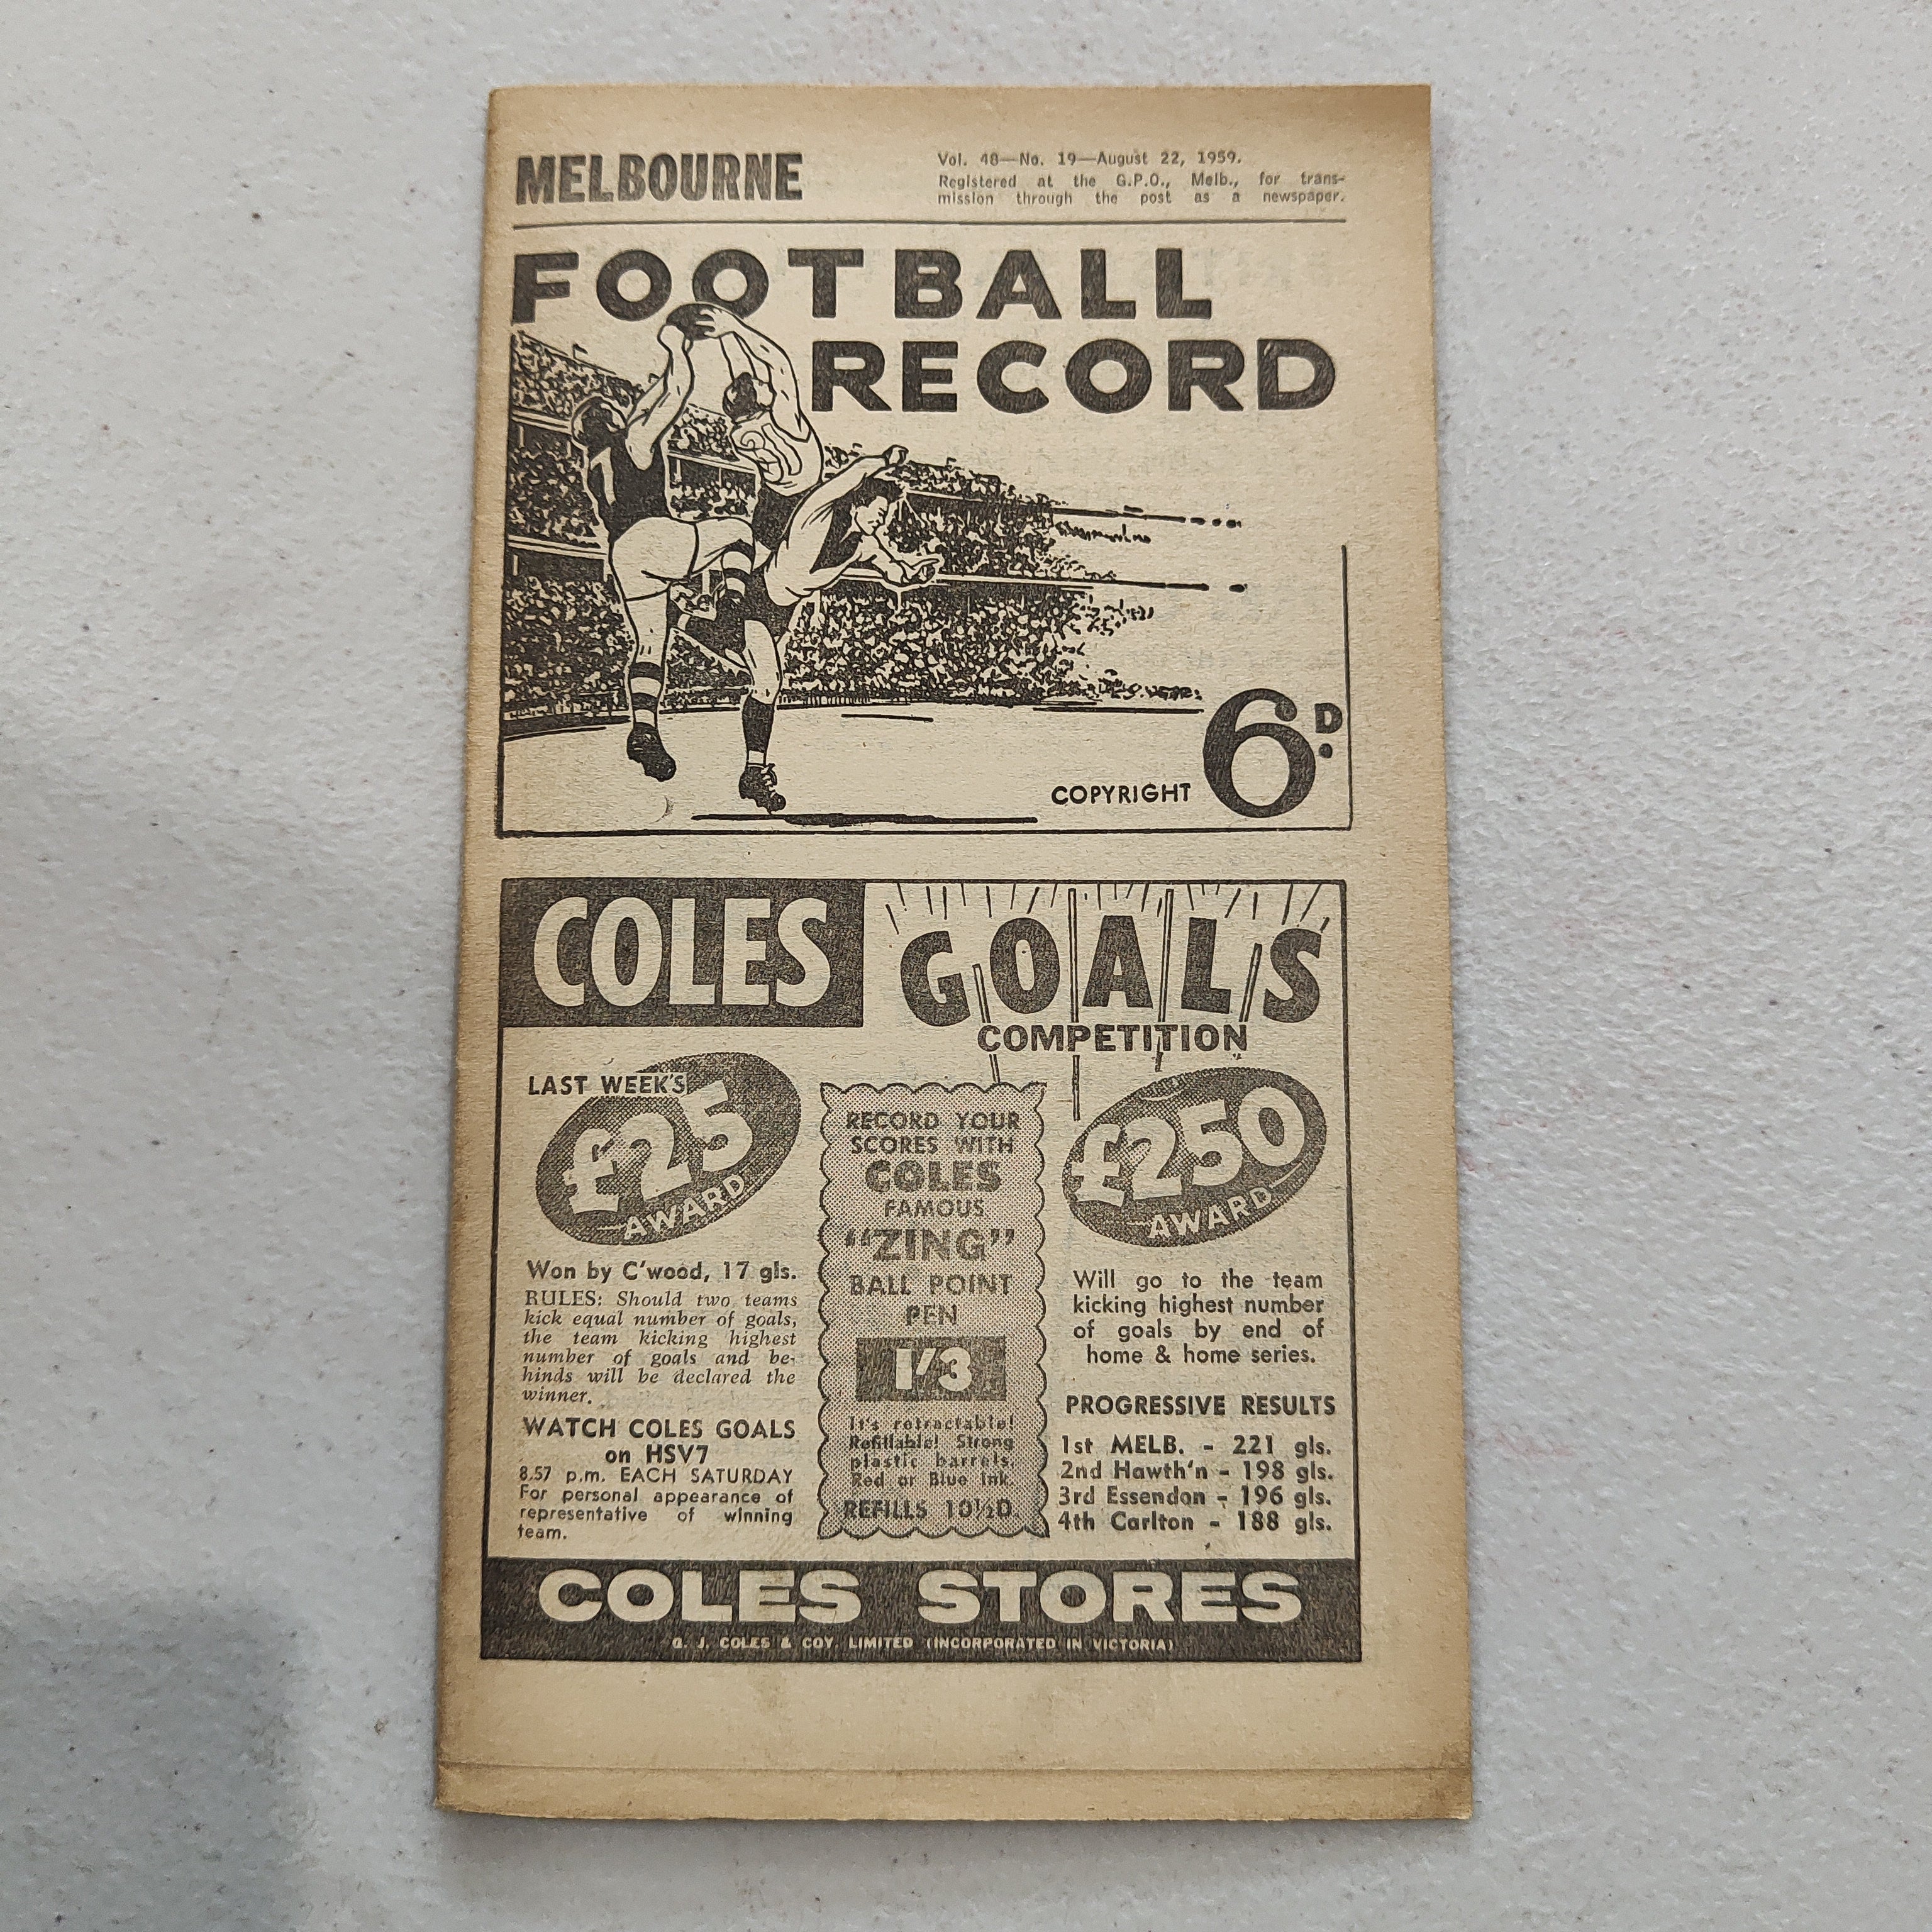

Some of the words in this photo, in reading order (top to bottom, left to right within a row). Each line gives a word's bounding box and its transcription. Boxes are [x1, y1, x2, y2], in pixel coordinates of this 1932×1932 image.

[937, 151, 967, 166] Vol.
[1160, 150, 1185, 167] 22,
[1198, 150, 1241, 165] 1959.
[516, 153, 803, 206] MELBOURNE
[938, 175, 1016, 190] Registered
[1037, 175, 1053, 187] at
[1073, 174, 1096, 187] the
[1116, 172, 1170, 189] G.P.O.,
[1191, 172, 1239, 187] Melb.,
[1259, 170, 1280, 186] for
[1301, 171, 1345, 186] trans-
[938, 191, 994, 205] mission
[1016, 191, 1072, 207] through
[1095, 191, 1118, 204] the
[1140, 191, 1172, 206] post
[1194, 192, 1209, 203] as
[1232, 192, 1240, 203] a
[1263, 191, 1345, 205] newspaper.
[511, 248, 1212, 326] FOOTBALL
[811, 338, 1336, 414] RECORD
[1051, 782, 1191, 806] COPYRIGHT
[533, 896, 831, 1008] COLES
[900, 915, 1322, 1027] GOALS
[977, 1024, 1248, 1052] COMPETITION
[528, 1075, 587, 1096] LAST
[601, 1073, 687, 1096] WEEK'S
[846, 1111, 939, 1130] RECORD
[955, 1112, 1019, 1130] YOUR
[561, 1079, 753, 1214] £25
[852, 1136, 937, 1154] SCORES
[955, 1136, 1013, 1154] WITH
[1067, 1086, 1305, 1207] £250
[865, 1160, 1002, 1192] COLES
[624, 1174, 746, 1241] AWARD
[884, 1199, 984, 1218] FAMOUS
[1149, 1187, 1273, 1240] AWARD
[527, 1259, 576, 1280] Won
[587, 1260, 612, 1283] by
[623, 1260, 711, 1284] C'wood,
[723, 1260, 750, 1279] 17
[760, 1261, 797, 1284] gls.
[1072, 1268, 1114, 1289] Will
[1136, 1272, 1162, 1293] go
[1182, 1271, 1201, 1289] to
[1221, 1267, 1254, 1289] the
[1272, 1271, 1323, 1289] team
[850, 1275, 911, 1296] BALL
[930, 1274, 1012, 1296] POINT
[525, 1289, 603, 1307] RULES:
[616, 1291, 682, 1307] Should
[696, 1292, 731, 1307] two
[745, 1293, 797, 1307] teams
[1073, 1294, 1146, 1317] kicking
[1158, 1294, 1234, 1317] highest
[1244, 1294, 1324, 1314] number
[523, 1309, 562, 1326] kick
[572, 1310, 624, 1328] equal
[633, 1310, 706, 1326] number
[716, 1310, 735, 1328] of
[746, 1310, 797, 1330] goals,
[906, 1304, 957, 1326] PEN
[523, 1330, 552, 1345] the
[572, 1331, 618, 1345] team
[638, 1329, 708, 1348] kicking
[729, 1330, 797, 1348] highest
[1073, 1318, 1096, 1340] of
[1118, 1318, 1172, 1343] goals
[1194, 1318, 1221, 1342] by
[1241, 1318, 1281, 1339] end
[1302, 1318, 1324, 1339] of
[522, 1348, 595, 1364] number
[613, 1348, 632, 1368] of
[650, 1349, 697, 1368] goals
[714, 1348, 750, 1365] and
[769, 1348, 796, 1365] be-
[1086, 1343, 1143, 1364] home
[1155, 1345, 1171, 1364] &
[1183, 1343, 1240, 1364] home
[1250, 1344, 1316, 1364] series.
[521, 1367, 572, 1384] hinds
[587, 1367, 625, 1384] will
[638, 1367, 659, 1384] be
[673, 1367, 752, 1384] declared
[766, 1368, 796, 1384] the
[522, 1387, 593, 1404] winner.
[1066, 1394, 1226, 1416] PROGRESSIVE
[1241, 1394, 1336, 1416] RESULTS
[522, 1416, 616, 1438] WATCH
[628, 1419, 703, 1439] COLES
[716, 1419, 796, 1439] GOALS
[849, 1416, 880, 1431] It's
[894, 1416, 1014, 1431] retractable!
[605, 1447, 631, 1464] on
[646, 1444, 709, 1464] HSV7
[957, 1434, 1013, 1452] Strong
[1062, 1435, 1093, 1455] 1st
[1110, 1434, 1184, 1455] MELB.
[1232, 1435, 1273, 1455] 221
[1294, 1435, 1331, 1459] gls.
[851, 1453, 917, 1470] plastic
[1060, 1460, 1102, 1480] 2nd
[1243, 1460, 1285, 1480] 198
[1296, 1461, 1334, 1484] gls.
[519, 1465, 552, 1482] 8.57
[566, 1469, 606, 1483] p.m.
[620, 1467, 677, 1484] EACH
[691, 1467, 794, 1484] SATURDAY
[852, 1472, 884, 1487] Red
[897, 1475, 916, 1487] or
[930, 1472, 968, 1487] Blue
[519, 1484, 548, 1501] For
[562, 1487, 638, 1504] personal
[653, 1491, 761, 1507] appearance
[775, 1488, 794, 1504] of
[1058, 1485, 1096, 1506] 3rd
[1106, 1485, 1206, 1506] Essendon
[1240, 1485, 1284, 1506] 196
[1293, 1486, 1331, 1509] gls.
[519, 1507, 648, 1522] representative
[677, 1507, 695, 1523] of
[724, 1508, 793, 1526] winning
[844, 1499, 928, 1519] REFILLS
[517, 1523, 567, 1540] team.
[1057, 1510, 1096, 1531] 4th
[1111, 1510, 1194, 1531] Carlton
[1237, 1510, 1279, 1531] 188
[1295, 1511, 1332, 1535] gls.
[538, 1568, 861, 1624] COLES
[918, 1570, 1302, 1624] STORES
[697, 1636, 709, 1648] J.
[719, 1636, 770, 1649] COLES
[780, 1636, 792, 1648] &
[802, 1636, 839, 1649] COY.
[848, 1636, 914, 1649] LIMITED
[926, 1636, 1057, 1650] (INCORPORATED
[1067, 1636, 1082, 1650] IN
[1092, 1637, 1174, 1652] VICTORIA)
